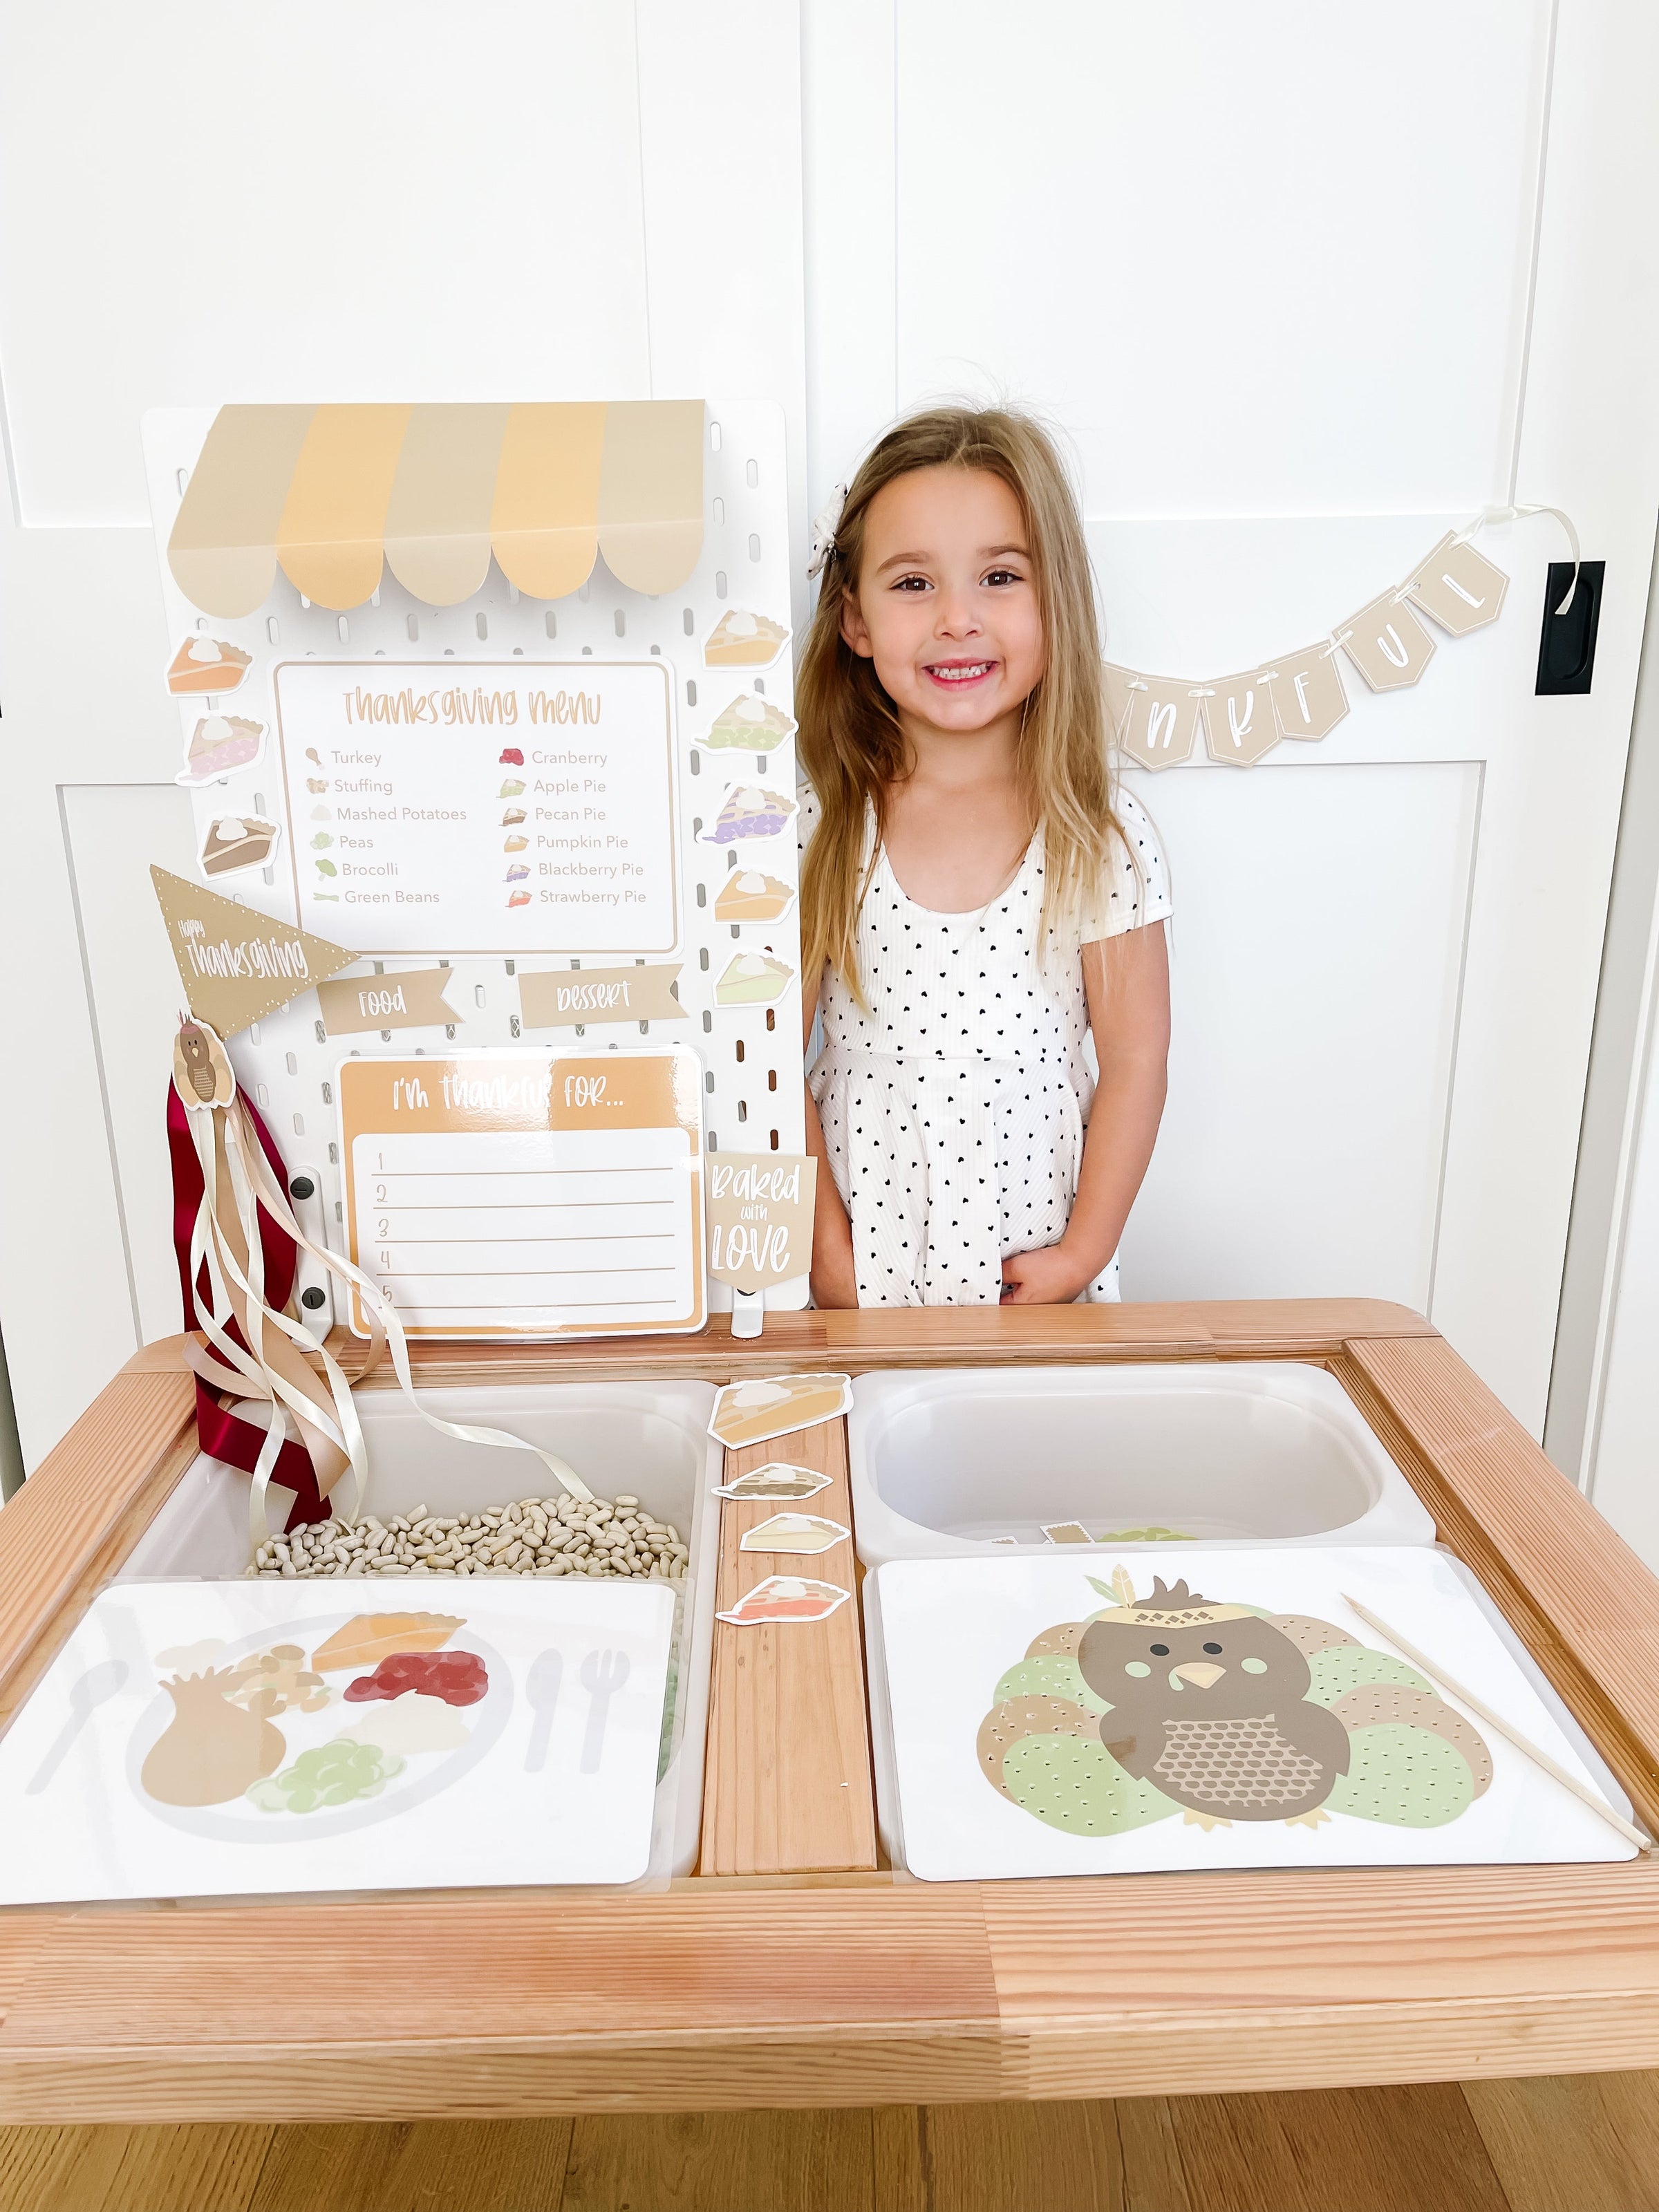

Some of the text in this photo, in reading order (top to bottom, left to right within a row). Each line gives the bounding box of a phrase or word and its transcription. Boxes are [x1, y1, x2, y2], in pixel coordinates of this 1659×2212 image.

[342, 686, 518, 725] Thanksgiving
[330, 750, 382, 768] Turkey
[532, 750, 608, 768] Cranberry
[334, 778, 393, 796] Stuffing
[534, 778, 606, 796] Apple Pie
[337, 807, 467, 821] Mashed Potatoes
[536, 807, 606, 821] Pecan Pie
[339, 835, 374, 849] Peas
[537, 834, 628, 852] Pumpkin Pie
[342, 862, 398, 876] Brocolli
[538, 862, 644, 879] Blackberry Pie
[344, 890, 440, 903] Green Beans
[540, 889, 646, 906] Strawberry Pie
[378, 1152, 383, 1170] 1
[711, 1163, 800, 1205] Baked
[377, 1184, 388, 1203] 2
[740, 1203, 768, 1221] with
[378, 1219, 389, 1237] 3
[381, 1251, 391, 1269] 4
[382, 1285, 393, 1302] 5
